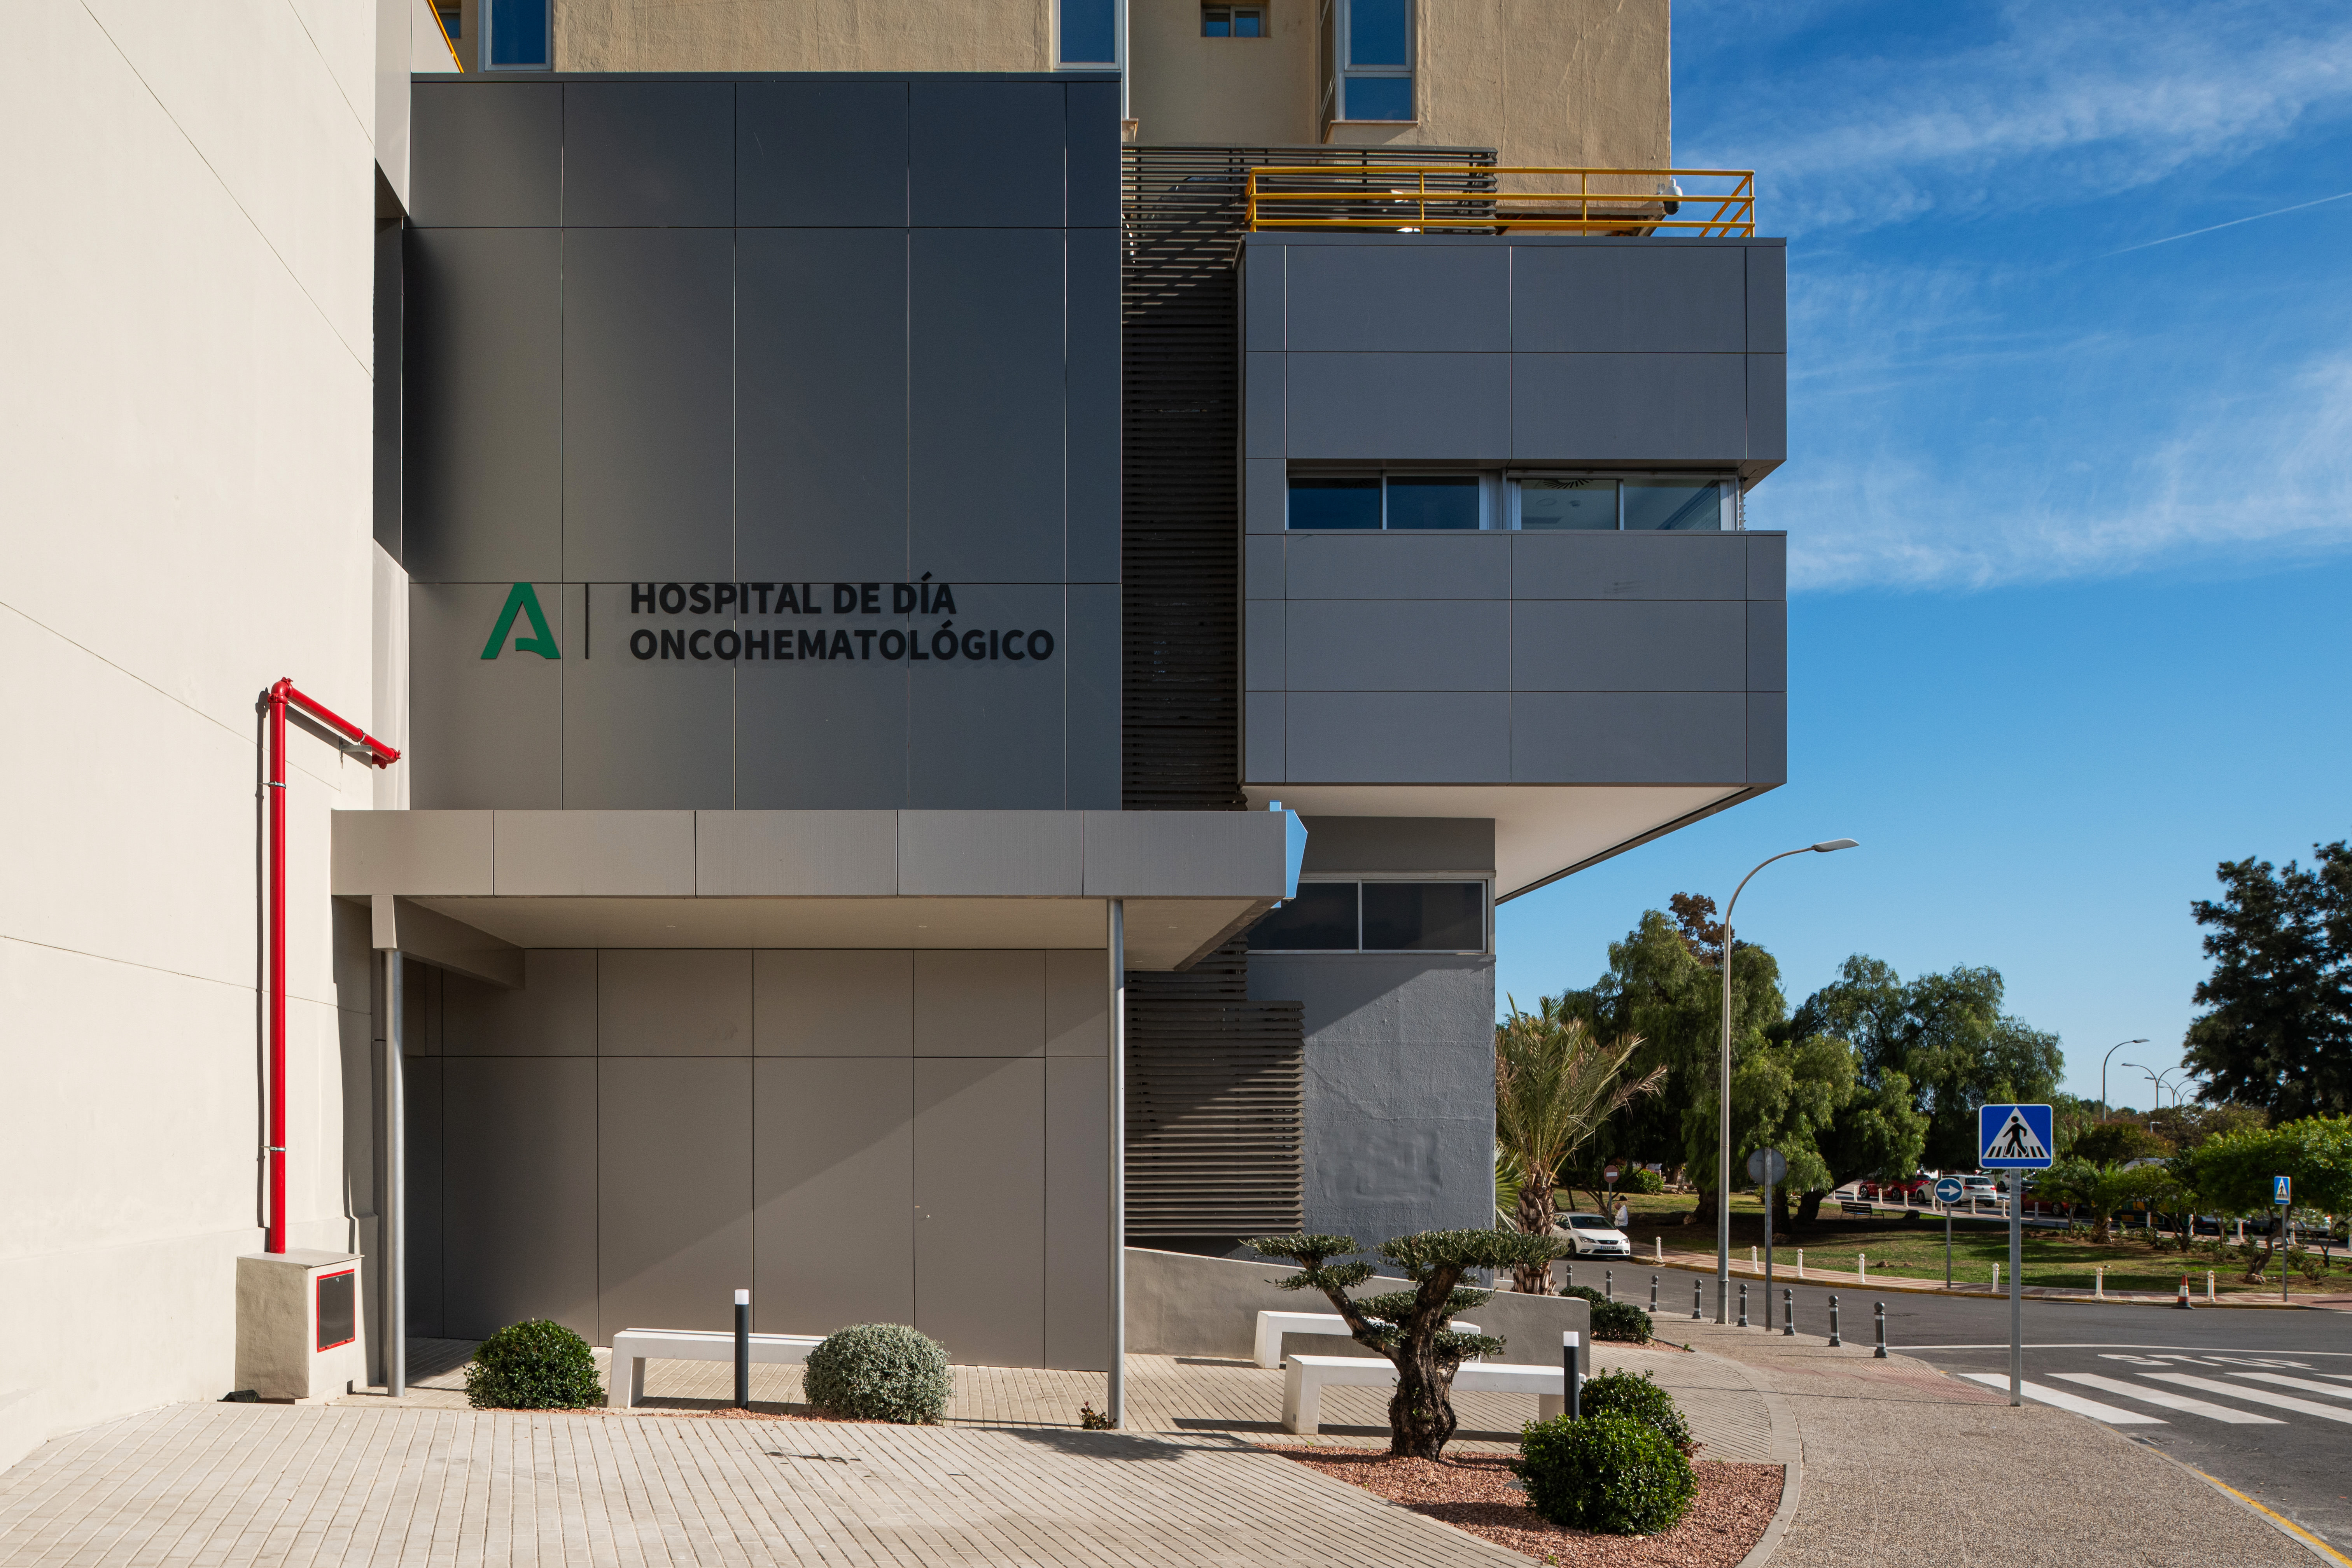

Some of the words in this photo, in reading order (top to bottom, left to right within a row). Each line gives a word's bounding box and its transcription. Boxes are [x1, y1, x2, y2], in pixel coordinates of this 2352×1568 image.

[631, 583, 821, 614] HOSPITAL
[833, 583, 881, 614] DE
[893, 570, 957, 614] DÍA
[630, 619, 1054, 660] ONCOHEMATOLÓGICO
[2098, 1354, 2319, 1370] STOP
